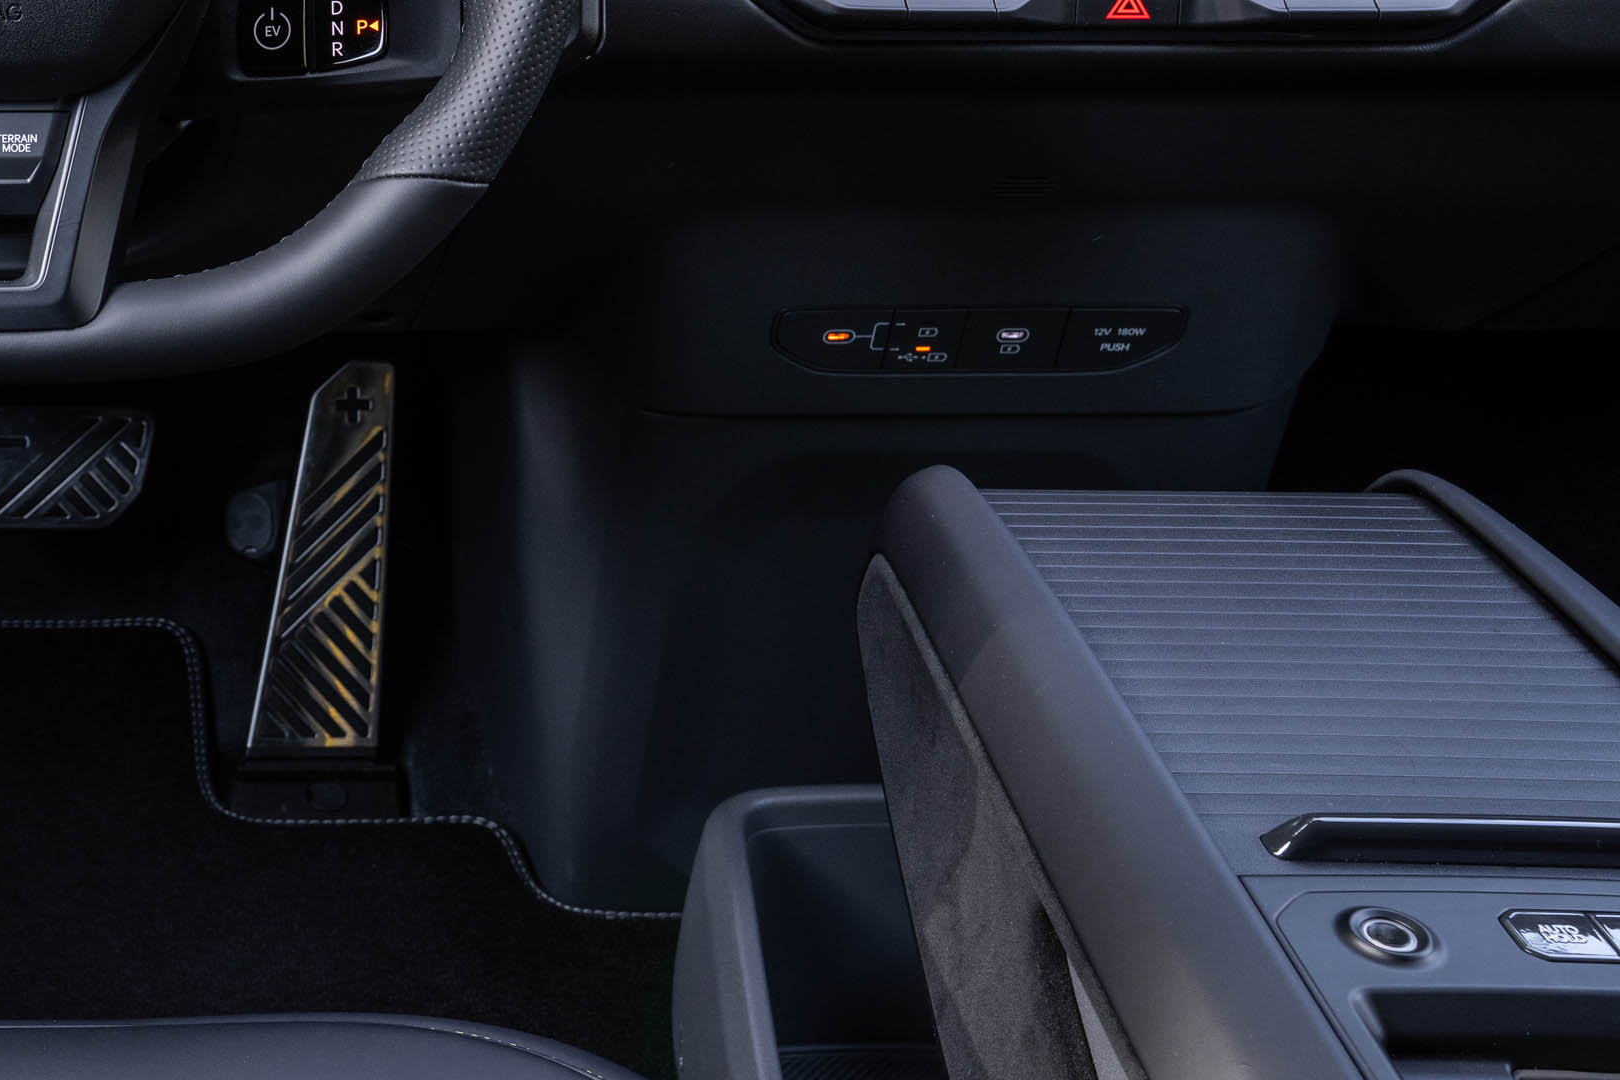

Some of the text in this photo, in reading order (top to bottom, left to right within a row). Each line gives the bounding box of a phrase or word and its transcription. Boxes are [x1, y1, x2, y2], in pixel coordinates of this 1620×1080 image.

[331, 0, 344, 16] D
[265, 24, 281, 38] EV
[331, 20, 344, 36] N
[356, 19, 369, 35] P
[331, 41, 344, 57] R
[1, 143, 33, 154] MODE
[1094, 327, 1147, 337] 12V 180W
[1099, 342, 1131, 352] PUSH
[1537, 924, 1580, 934] AUTO
[1541, 933, 1588, 944] HOLD
